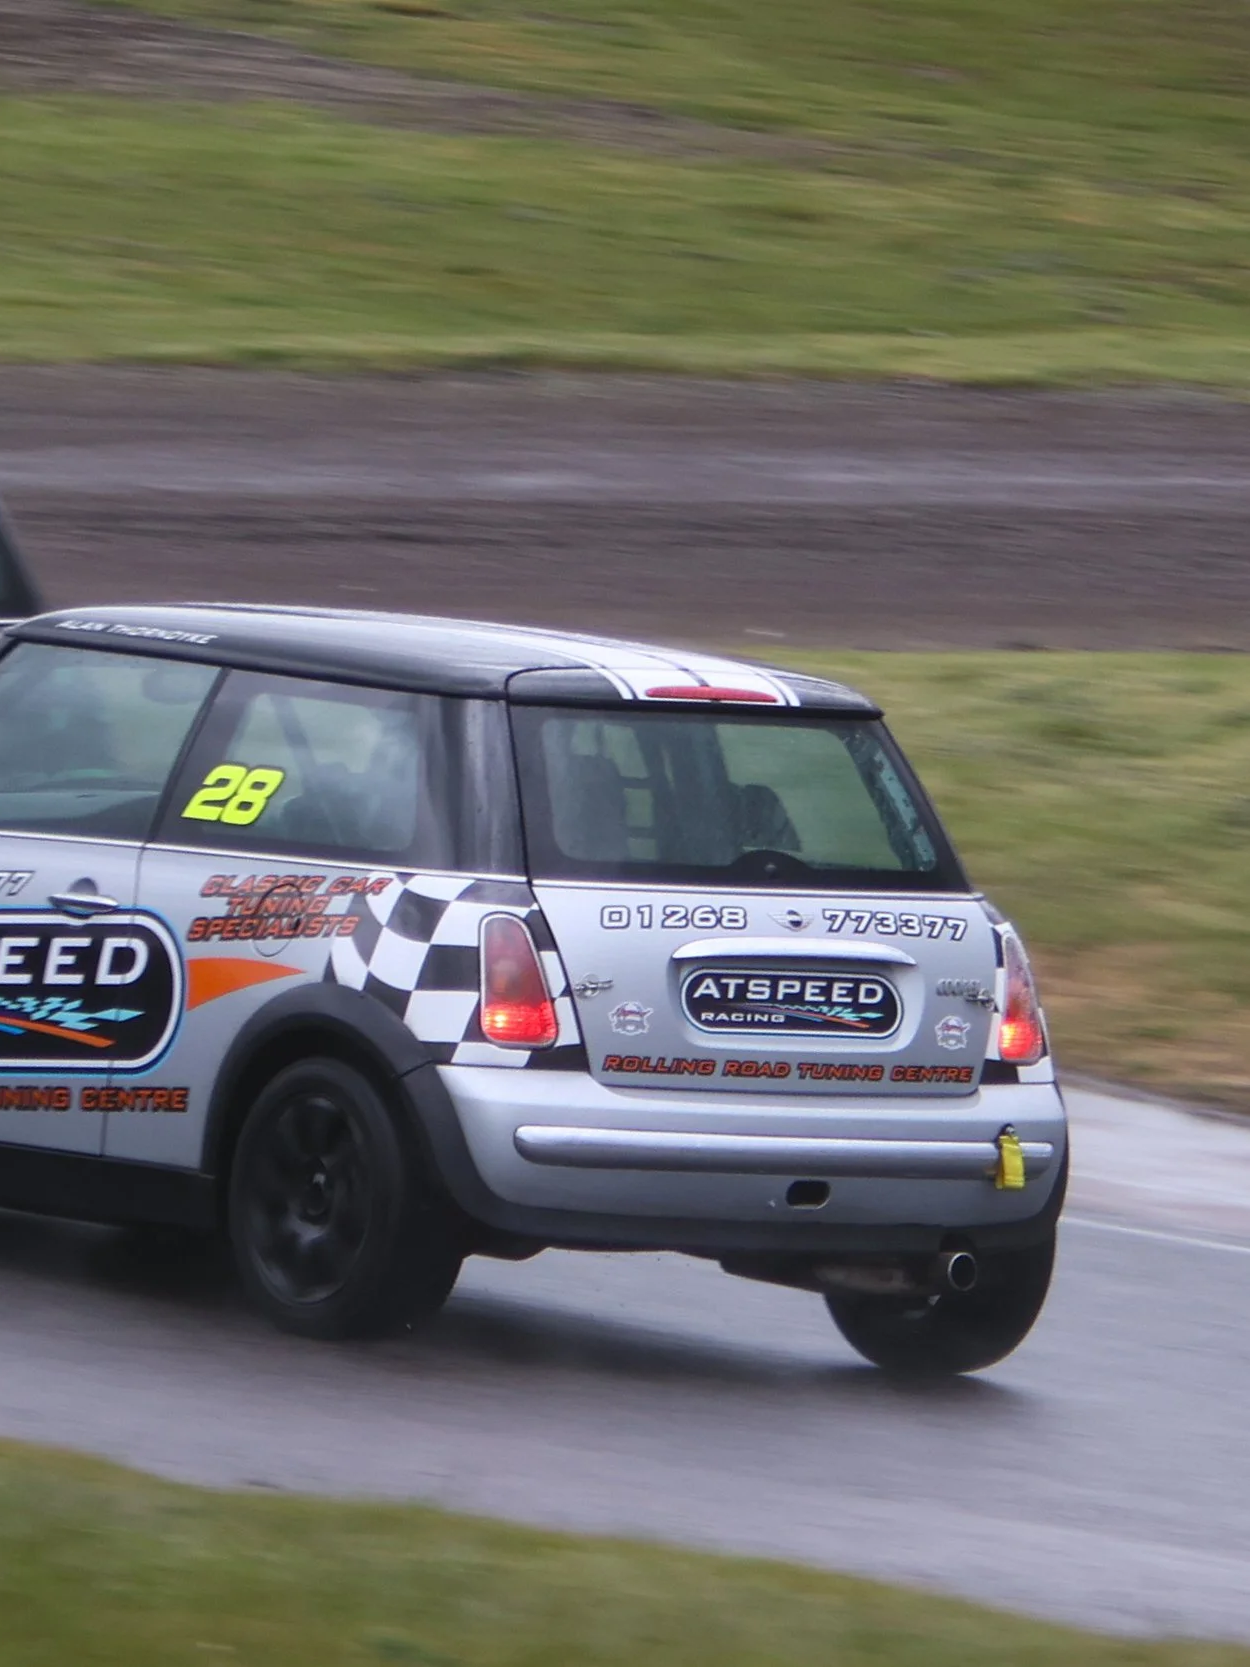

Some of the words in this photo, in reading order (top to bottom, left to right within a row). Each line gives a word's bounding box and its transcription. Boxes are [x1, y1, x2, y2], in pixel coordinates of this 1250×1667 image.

[181, 764, 285, 825] 28
[200, 874, 326, 897] CLASSIC
[326, 877, 394, 896] CAR
[225, 895, 331, 917] TUNING
[188, 915, 360, 941] SPECIALISTS
[600, 904, 747, 931] 01268
[822, 908, 968, 941] 773377
[692, 976, 884, 1005] ATSPEED
[701, 1011, 786, 1024] RACING
[603, 1054, 716, 1077] ROLLING
[722, 1058, 791, 1080] ROAD
[797, 1061, 884, 1083] TUNING
[890, 1063, 975, 1084] CENTRE
[79, 1086, 189, 1113] CENTRE
